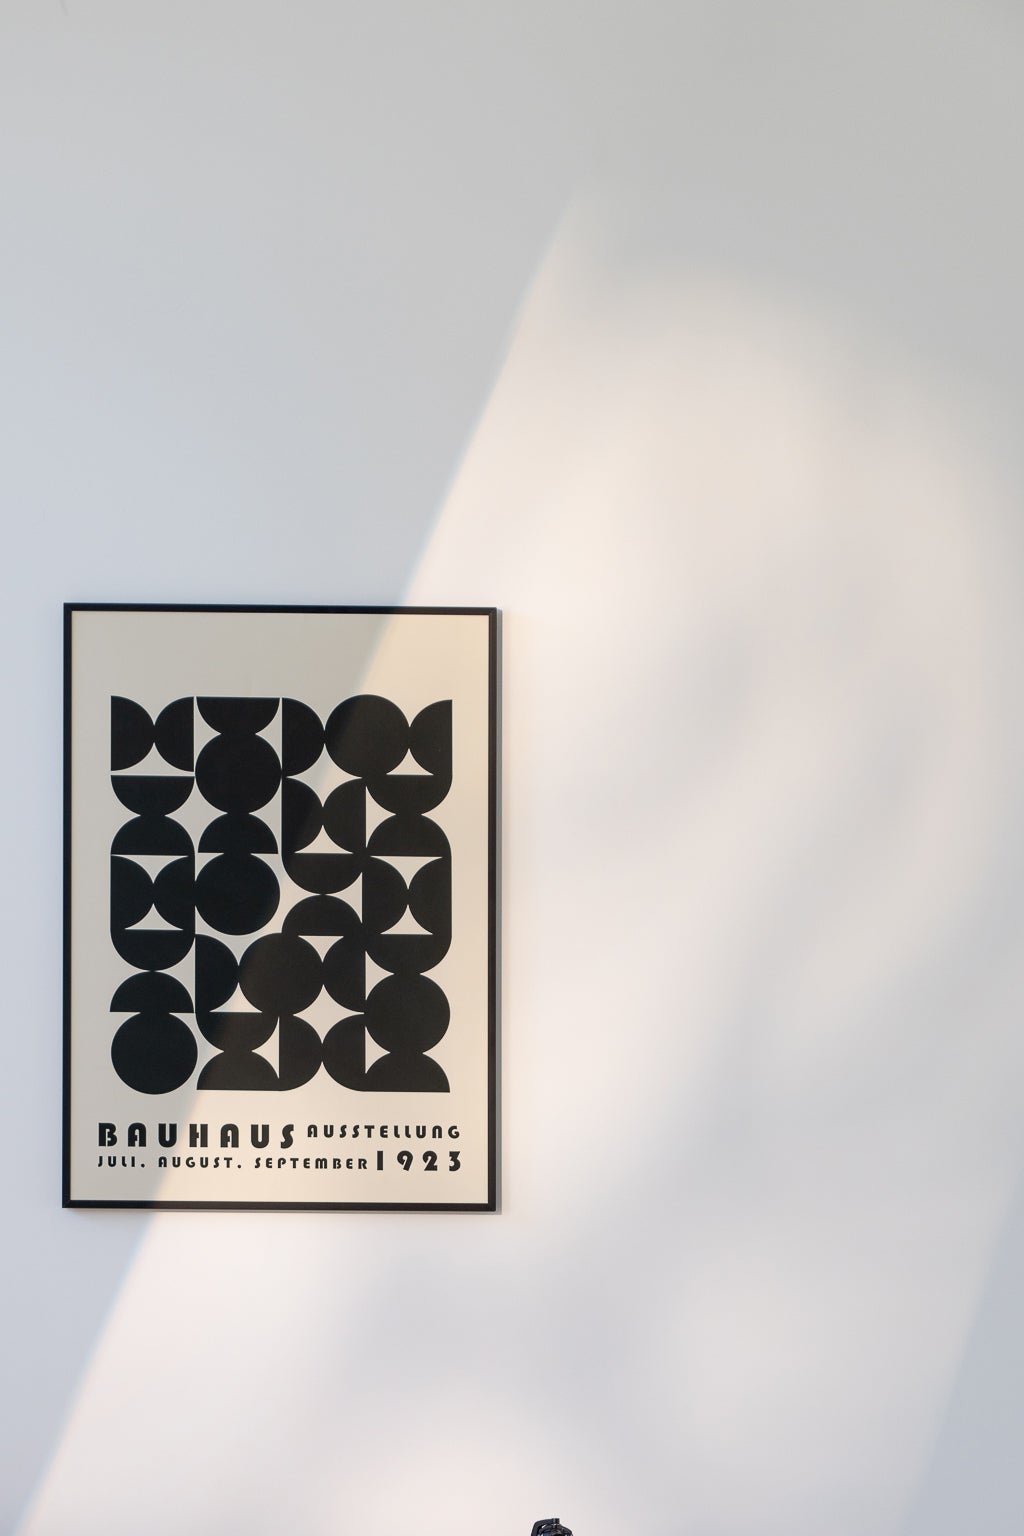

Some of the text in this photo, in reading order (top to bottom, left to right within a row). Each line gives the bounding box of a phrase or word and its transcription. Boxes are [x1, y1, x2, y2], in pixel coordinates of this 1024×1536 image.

[97, 1122, 461, 1149] BAUHAUS AUSSTELLUNG
[97, 1150, 461, 1173] JULI. AUGUST. SEPTEMBER 1923
